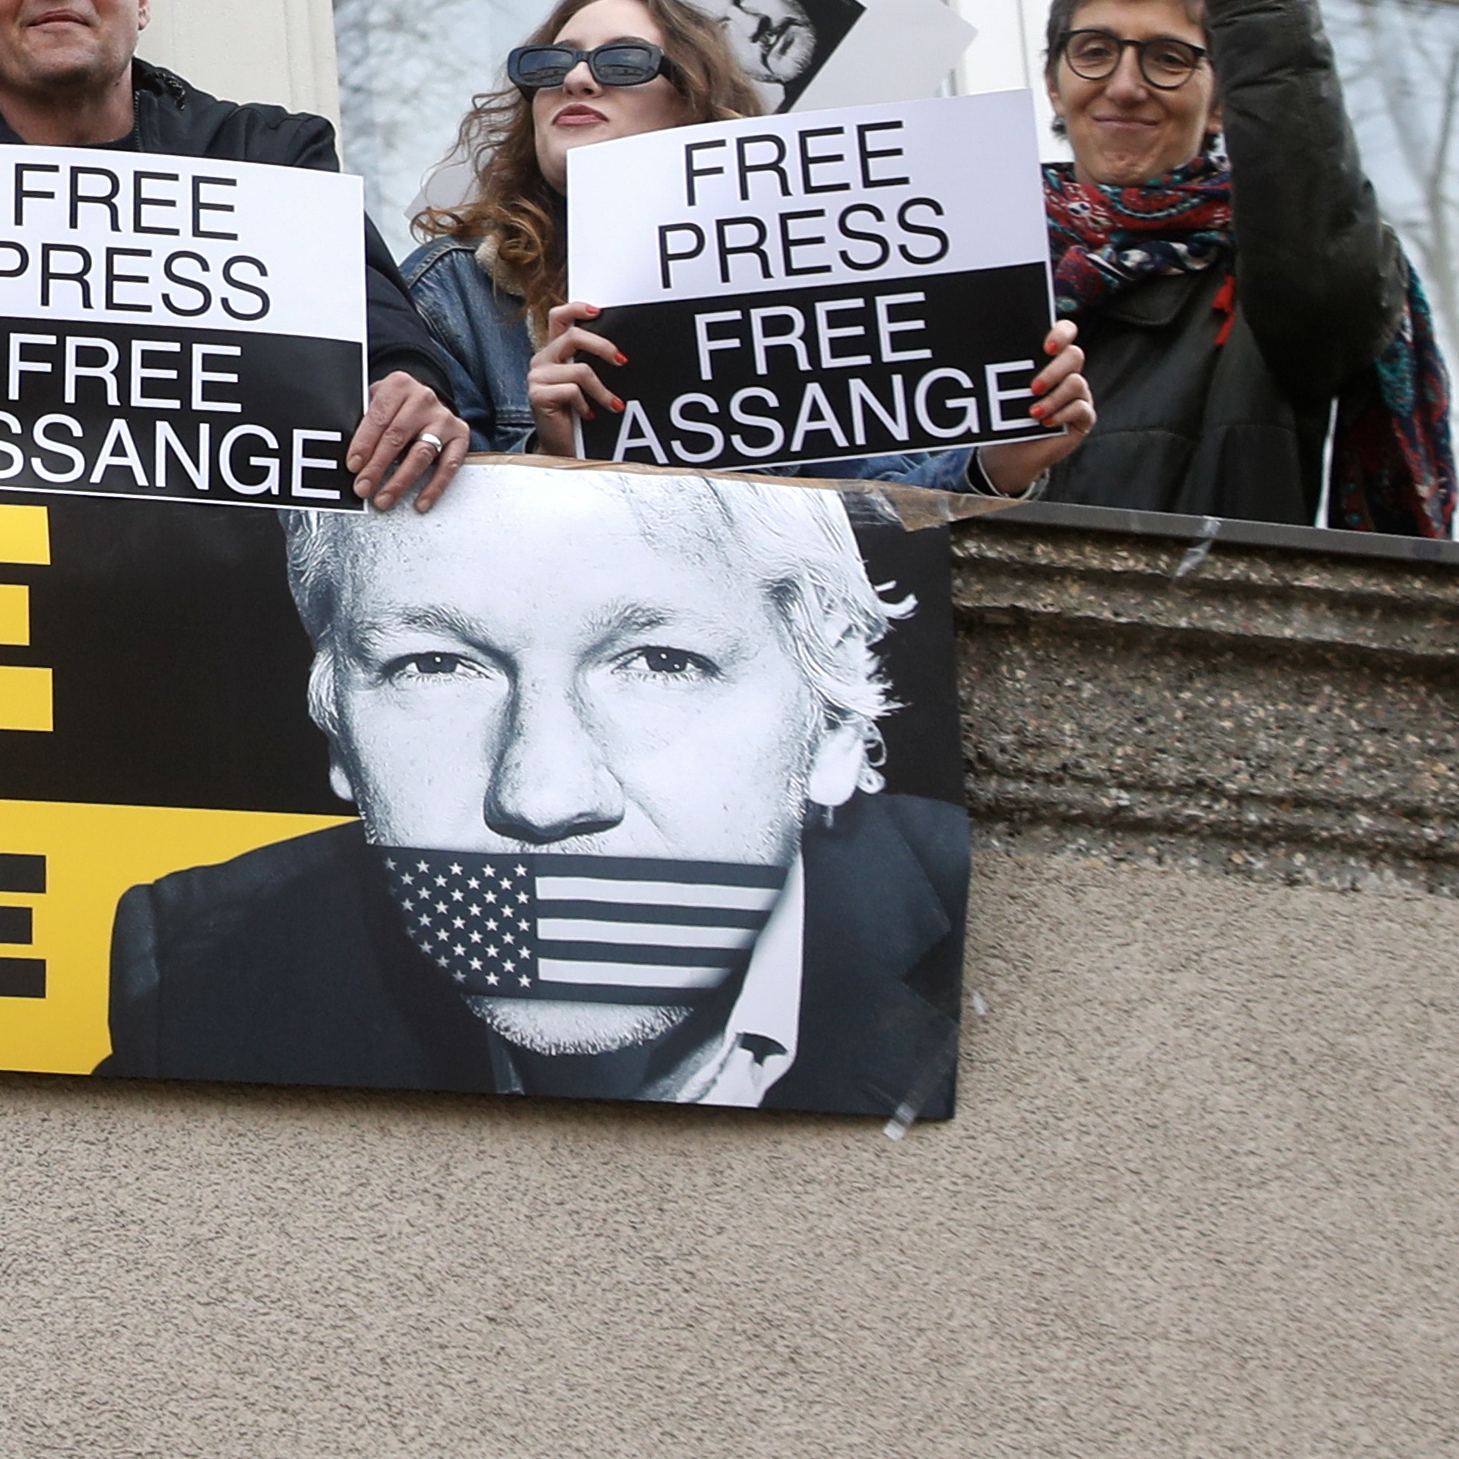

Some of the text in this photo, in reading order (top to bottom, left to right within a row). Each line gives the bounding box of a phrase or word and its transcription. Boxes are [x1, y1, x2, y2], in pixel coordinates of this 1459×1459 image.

[13, 162, 238, 241] FREE
[685, 119, 911, 207] FREE
[658, 197, 950, 289] PRESS
[8, 332, 242, 413] FREE
[694, 291, 933, 381] FREE
[612, 359, 1049, 465] ASSANGE
